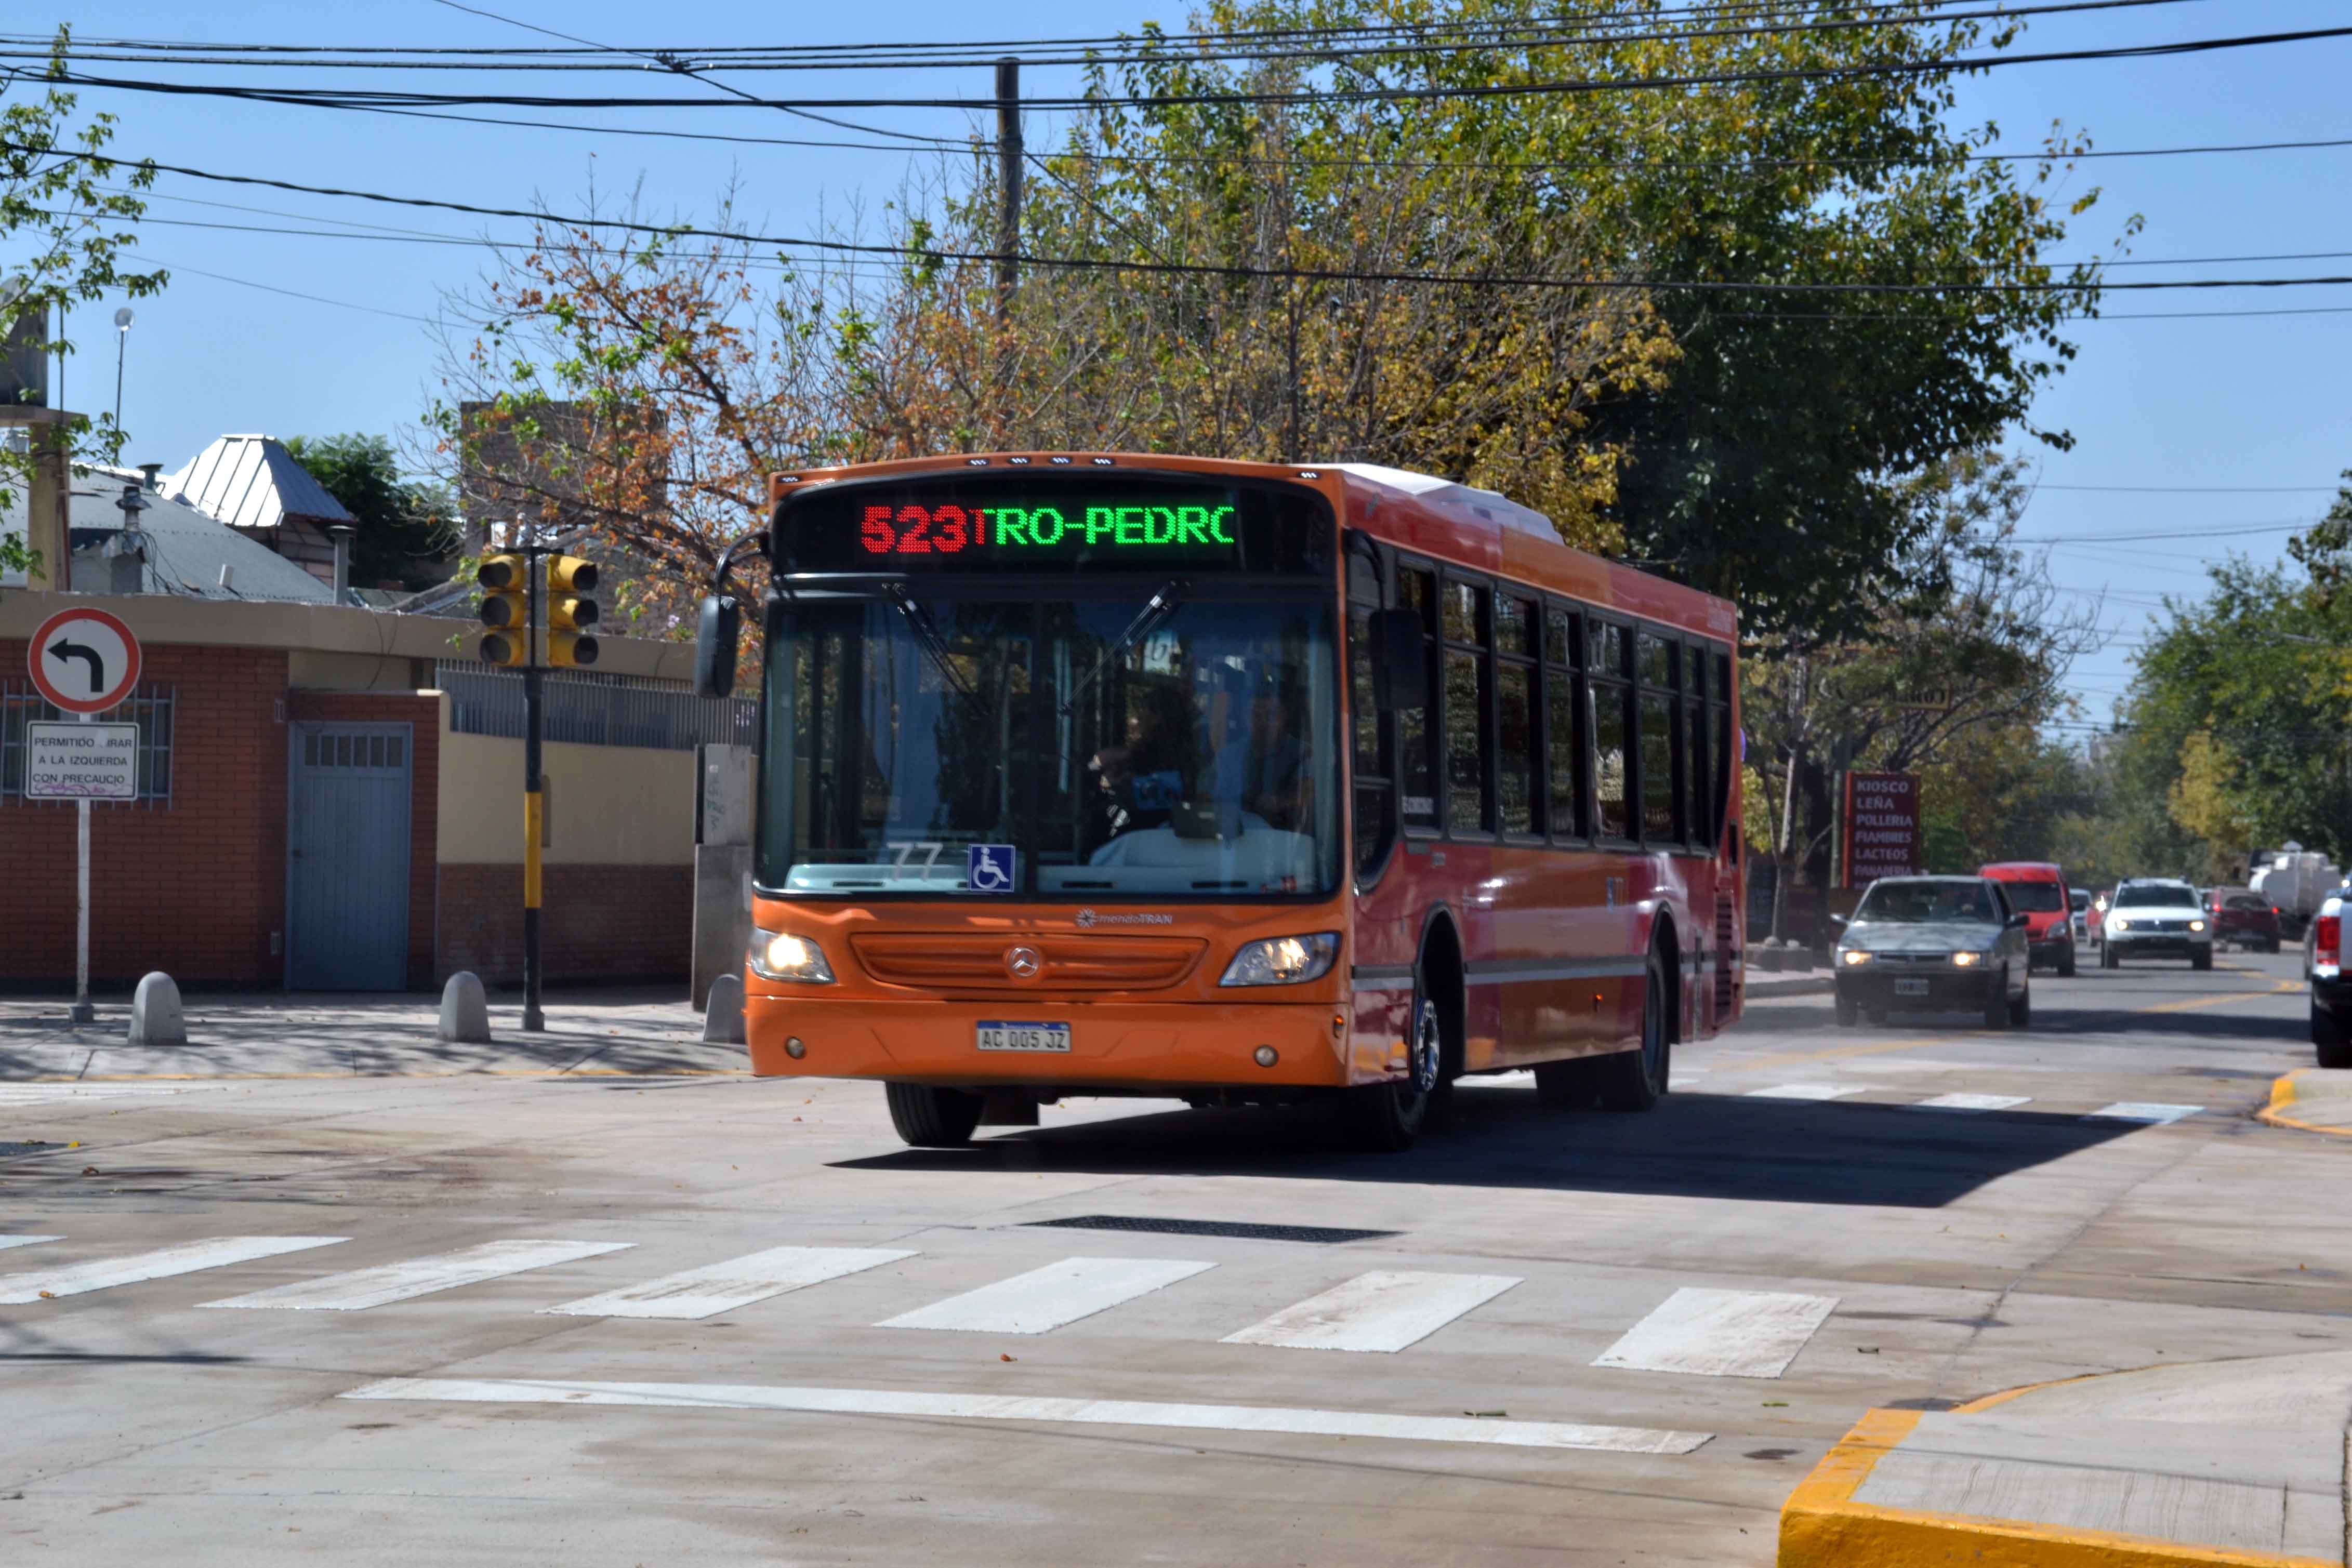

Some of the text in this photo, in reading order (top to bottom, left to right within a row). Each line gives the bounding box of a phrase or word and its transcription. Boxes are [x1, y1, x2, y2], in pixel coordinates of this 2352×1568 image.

[861, 505, 967, 553] 523
[34, 737, 132, 748] PERMITIDO IRAR
[38, 755, 127, 766] A LA IZQUIERDA
[33, 773, 58, 782] CON
[1857, 780, 1909, 793] KIOSCO
[1856, 795, 1894, 809] LEÑA
[1856, 814, 1913, 827] POLLERIA
[1854, 831, 1913, 844] FIAMBRES
[1854, 847, 1909, 861] LACTEOS
[887, 842, 944, 882] 77
[982, 1031, 1066, 1049] AC 005 JZ
